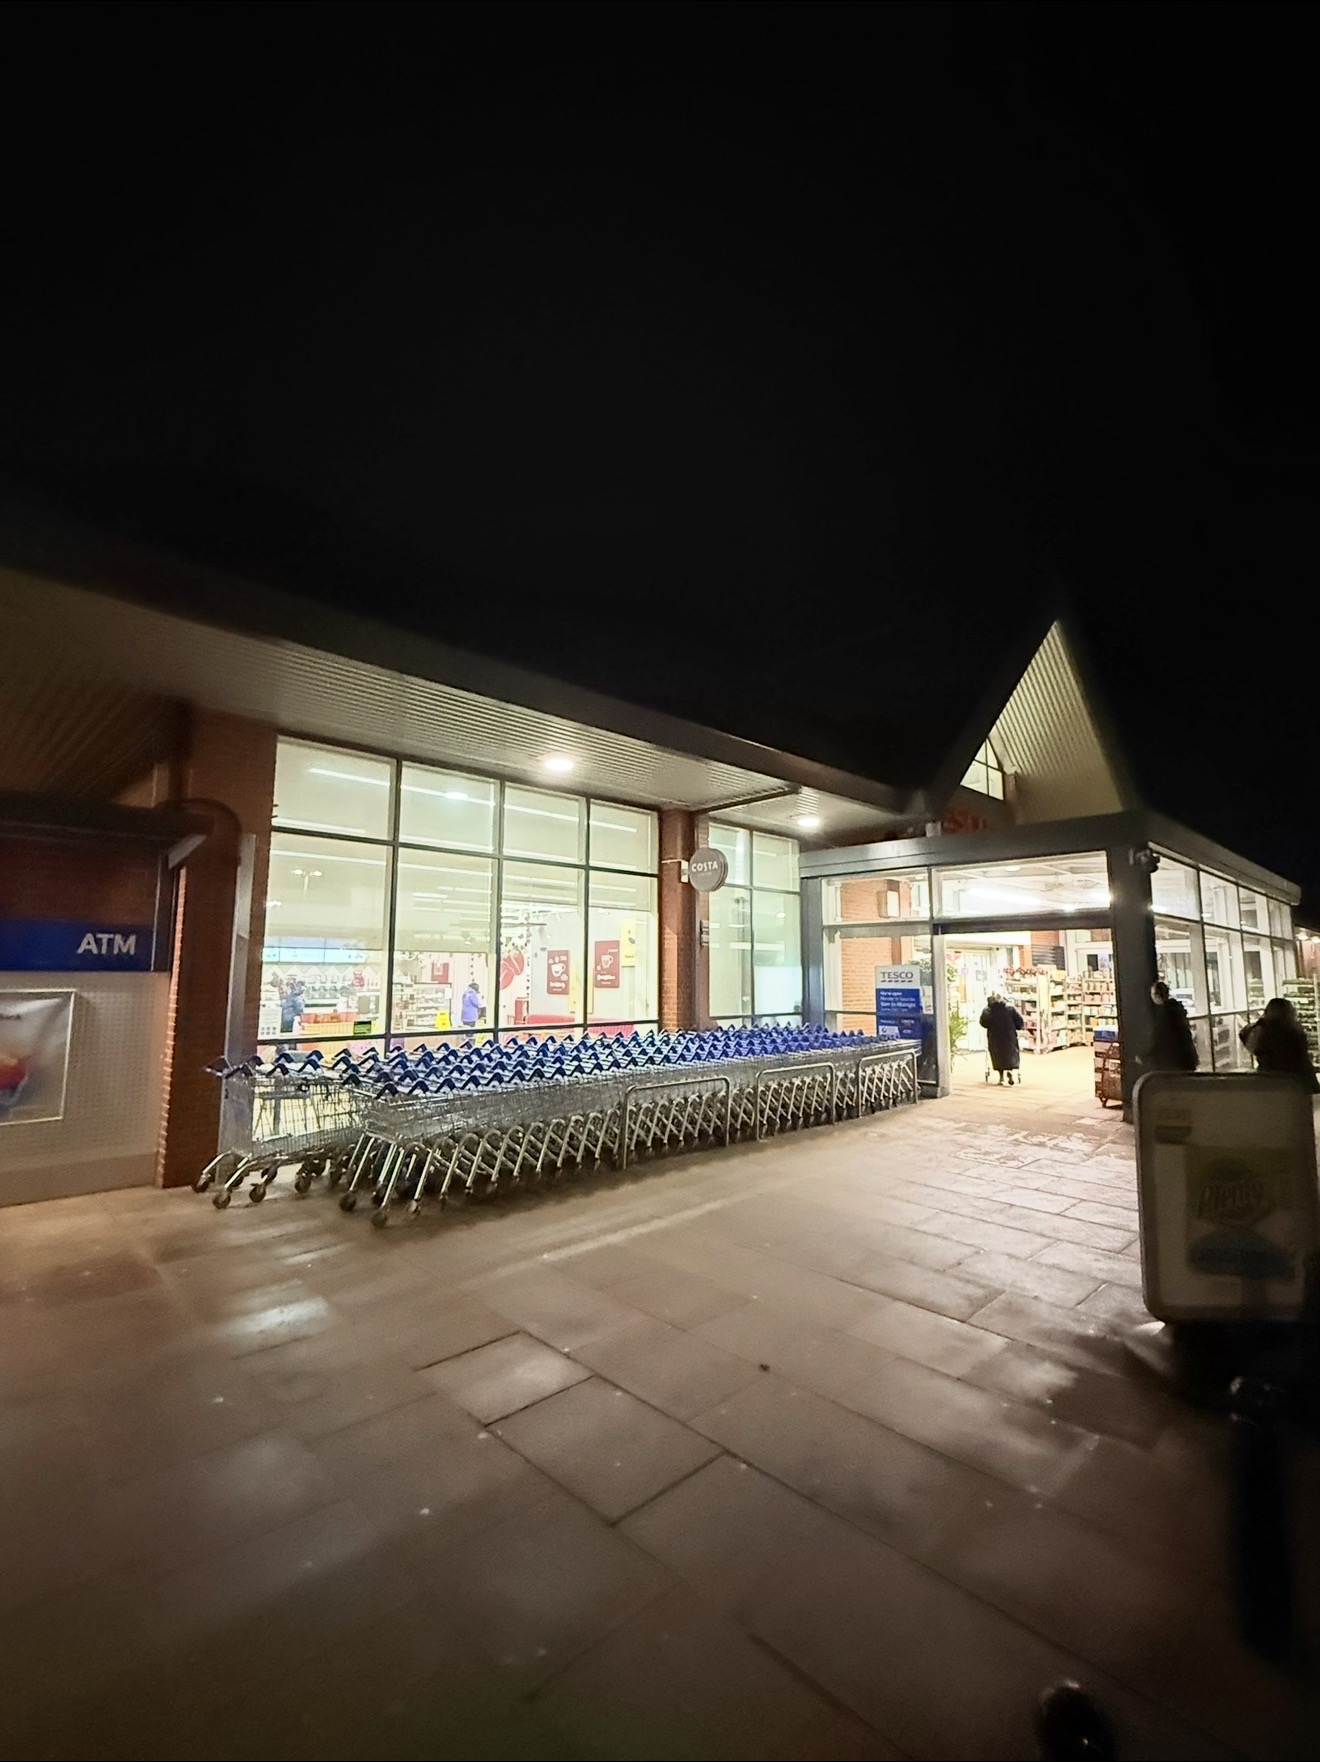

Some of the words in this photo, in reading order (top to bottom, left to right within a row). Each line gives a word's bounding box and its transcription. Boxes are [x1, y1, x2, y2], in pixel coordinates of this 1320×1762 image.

[691, 861, 719, 872] COSTA
[77, 933, 136, 955] ATM
[880, 971, 914, 979] TESCO
